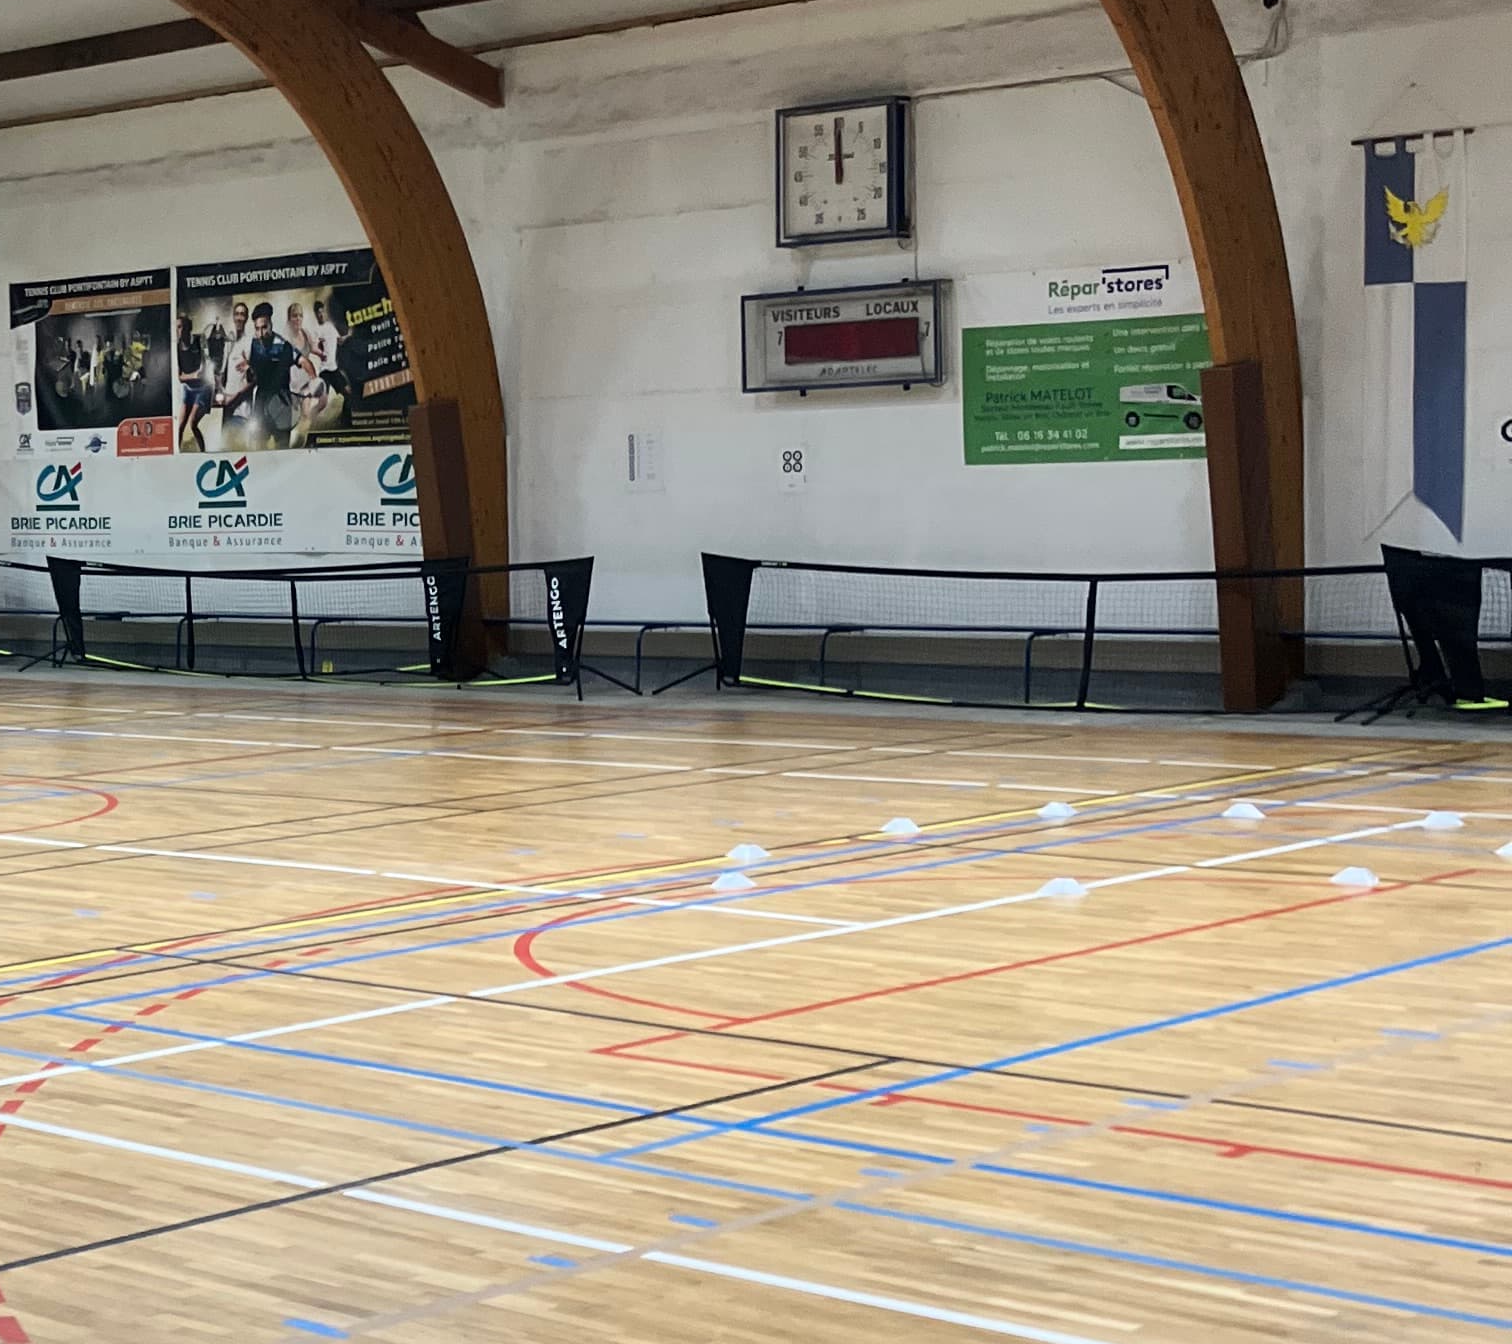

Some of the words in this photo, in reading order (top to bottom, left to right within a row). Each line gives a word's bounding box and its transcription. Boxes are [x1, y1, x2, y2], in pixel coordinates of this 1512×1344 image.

[185, 275, 217, 289] TENNIS
[217, 273, 239, 286] CLUB
[306, 265, 320, 277] BY
[771, 305, 841, 323] VISITEURS
[865, 300, 920, 317] LOCAUX
[985, 391, 1026, 404] Patrick
[1030, 387, 1093, 401] MATELOT
[11, 517, 41, 530] BRIE
[46, 516, 112, 530] PICARDIE
[168, 514, 202, 529] BRIE
[208, 513, 284, 528] PICARDIE
[346, 512, 385, 527] BRIE
[11, 537, 46, 549] Banque
[49, 537, 57, 548] &
[61, 537, 112, 548] Assurance
[168, 536, 208, 549] Banque
[213, 536, 221, 547] &
[226, 536, 283, 547] Assurance
[346, 535, 389, 549] Banque
[395, 535, 404, 546] &
[549, 576, 568, 649] ARTENGO
